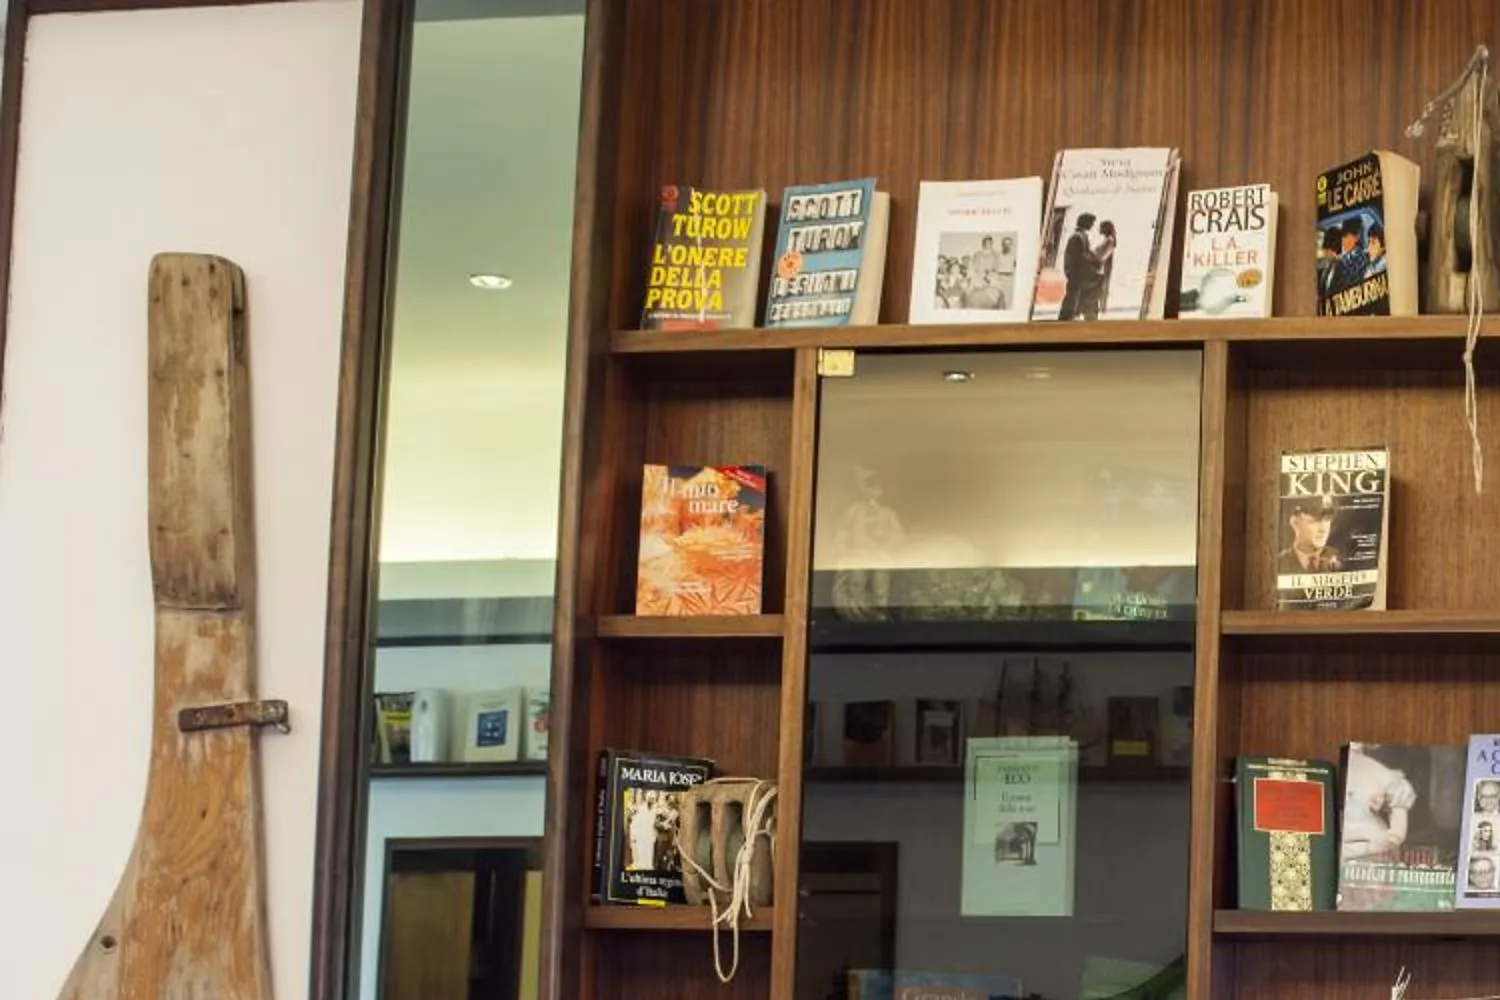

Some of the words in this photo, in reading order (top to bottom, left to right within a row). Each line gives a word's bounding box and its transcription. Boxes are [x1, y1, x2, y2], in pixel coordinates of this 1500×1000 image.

[1336, 161, 1373, 186] JOHN
[689, 191, 760, 214] SCOTT
[788, 191, 860, 220] SCOTT
[1190, 186, 1266, 211] ROBERT
[1328, 187, 1342, 213] LE
[672, 214, 753, 239] TUROW
[1190, 207, 1266, 234] CRAIS
[654, 244, 749, 269] L'ONERE
[1191, 250, 1258, 268] KILLER
[650, 266, 723, 287] DELLA
[645, 288, 724, 311] PROVA
[1289, 453, 1380, 472] STEPHEN
[1288, 471, 1381, 496] KING
[689, 499, 740, 514] mare
[1304, 584, 1354, 600] VERDE
[1477, 749, 1488, 762] A
[621, 767, 668, 784] MARIA
